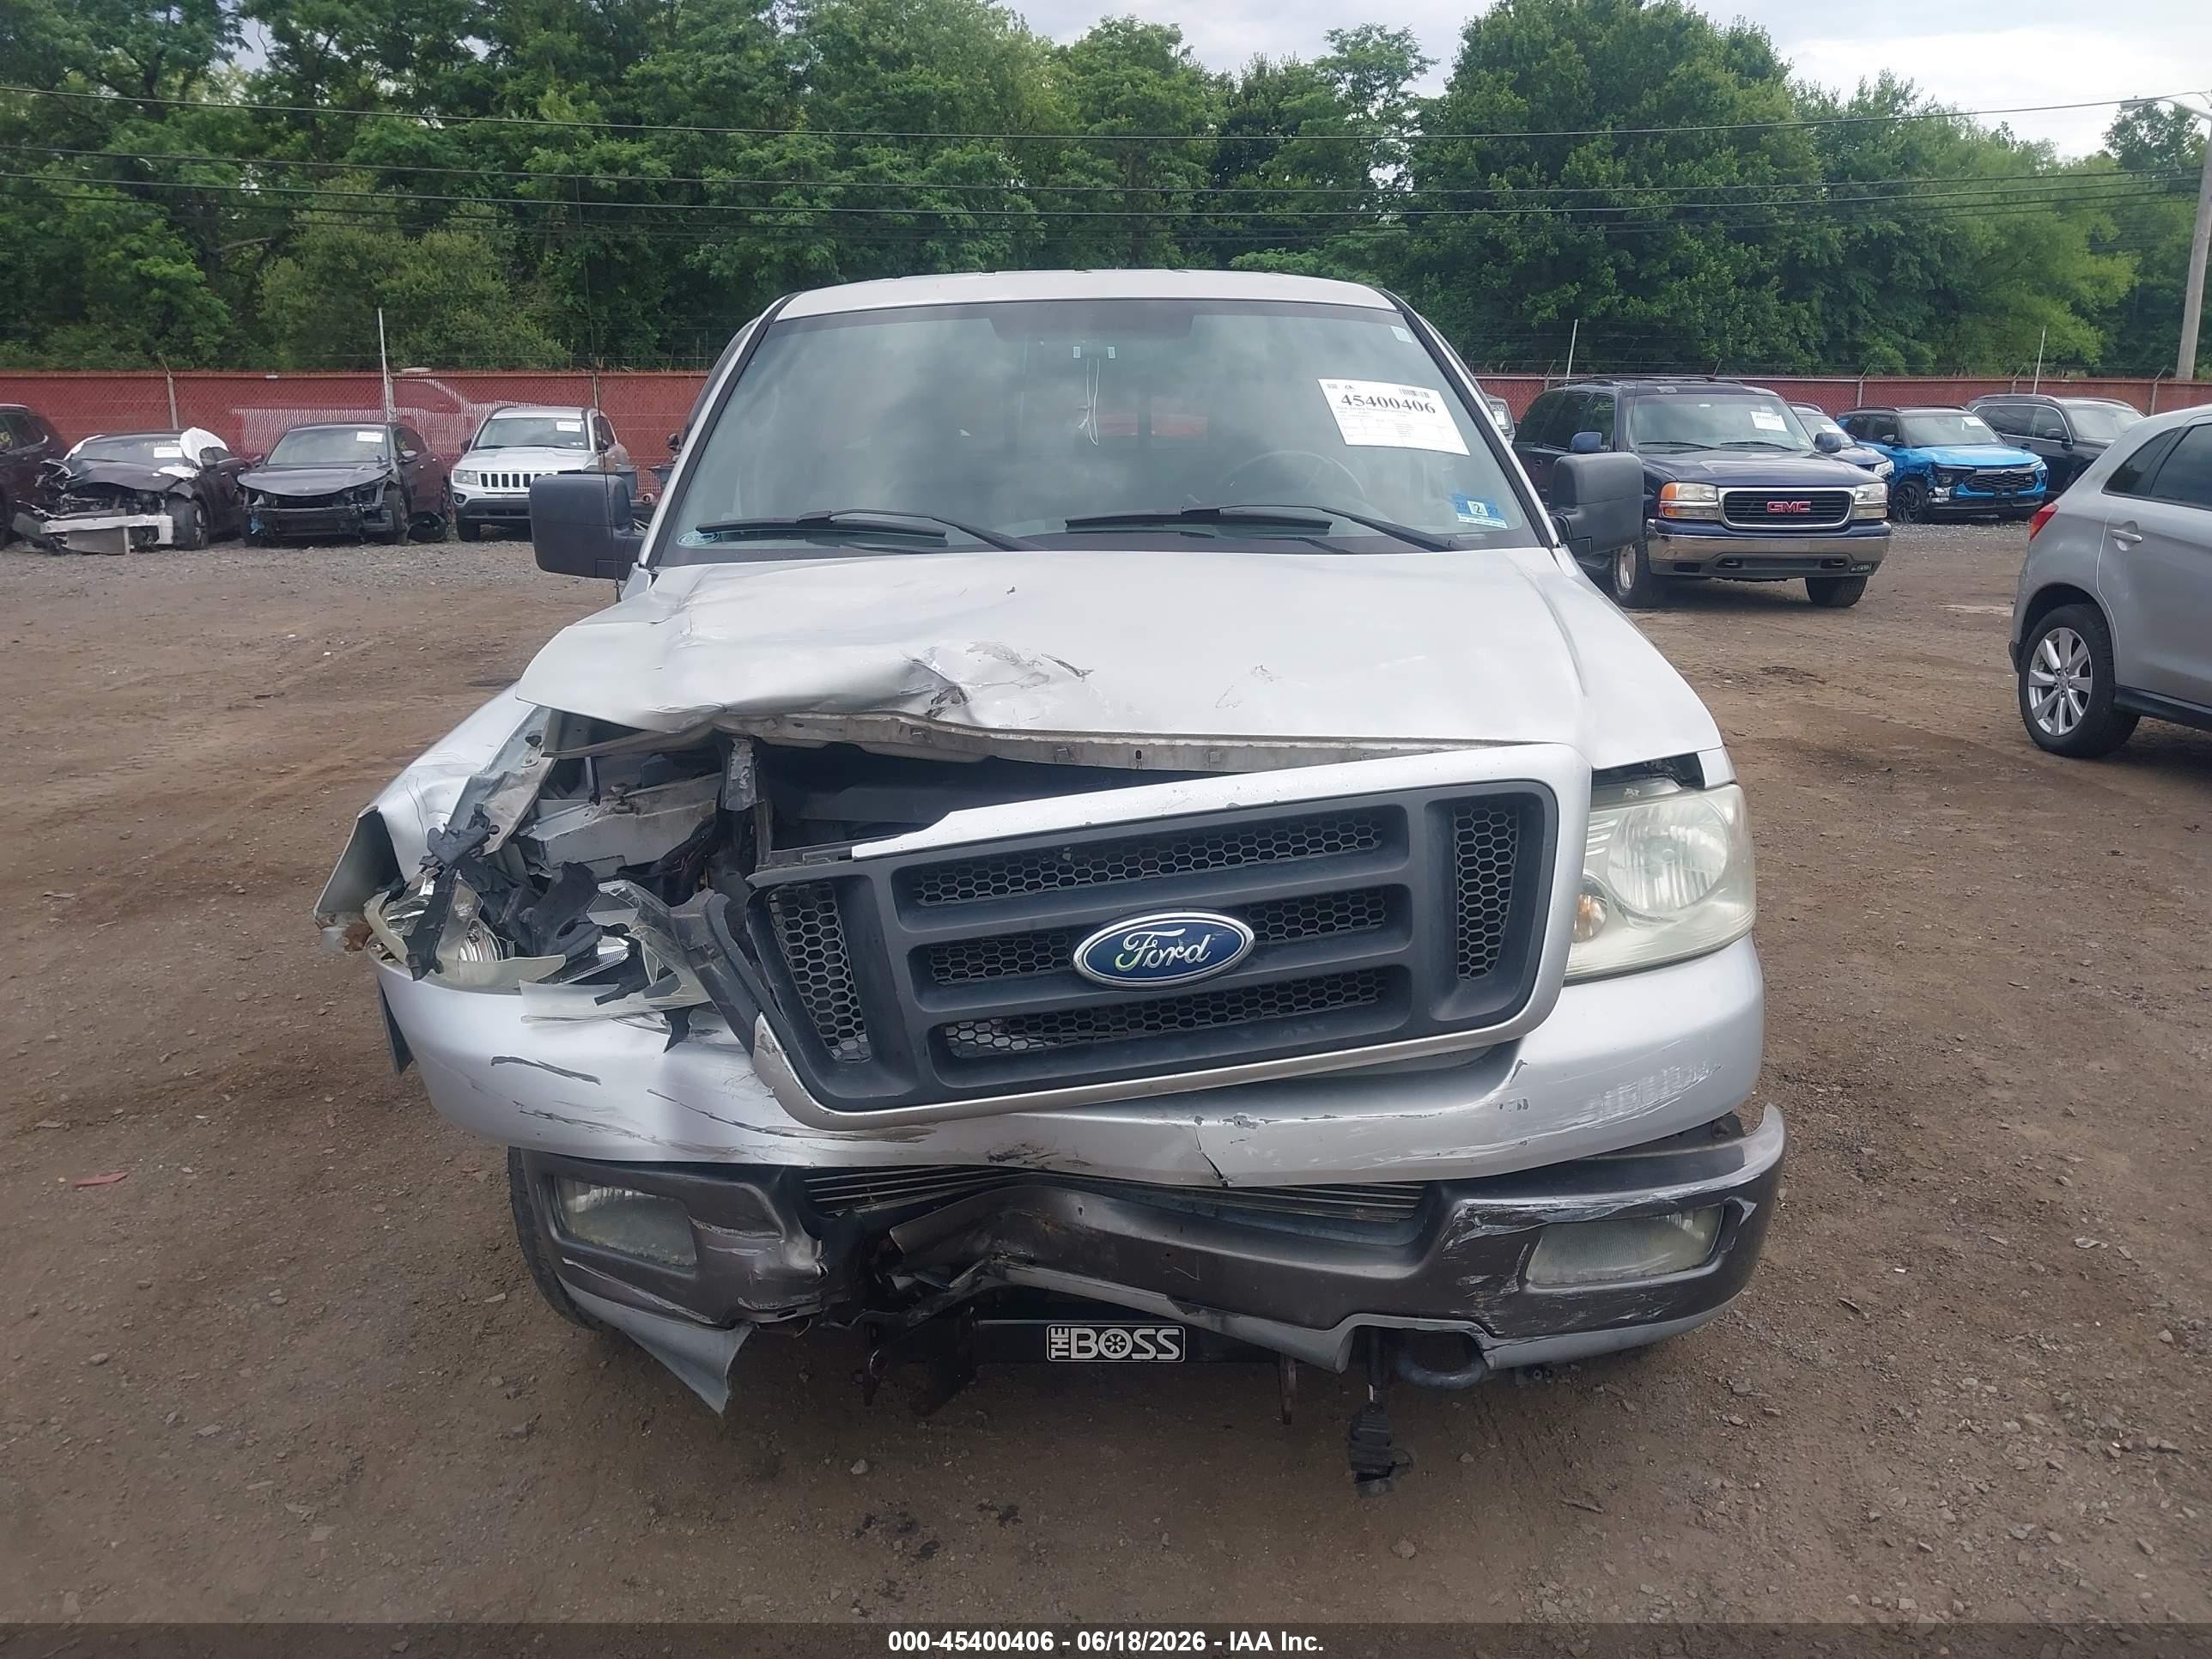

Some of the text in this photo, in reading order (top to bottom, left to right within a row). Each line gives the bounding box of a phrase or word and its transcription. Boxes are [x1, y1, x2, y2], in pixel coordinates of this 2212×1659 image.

[1341, 393, 1437, 414] 45400406
[1766, 501, 1812, 514] GMC
[1115, 927, 1212, 972] Ford
[1050, 1328, 1181, 1360] THE BOSS
